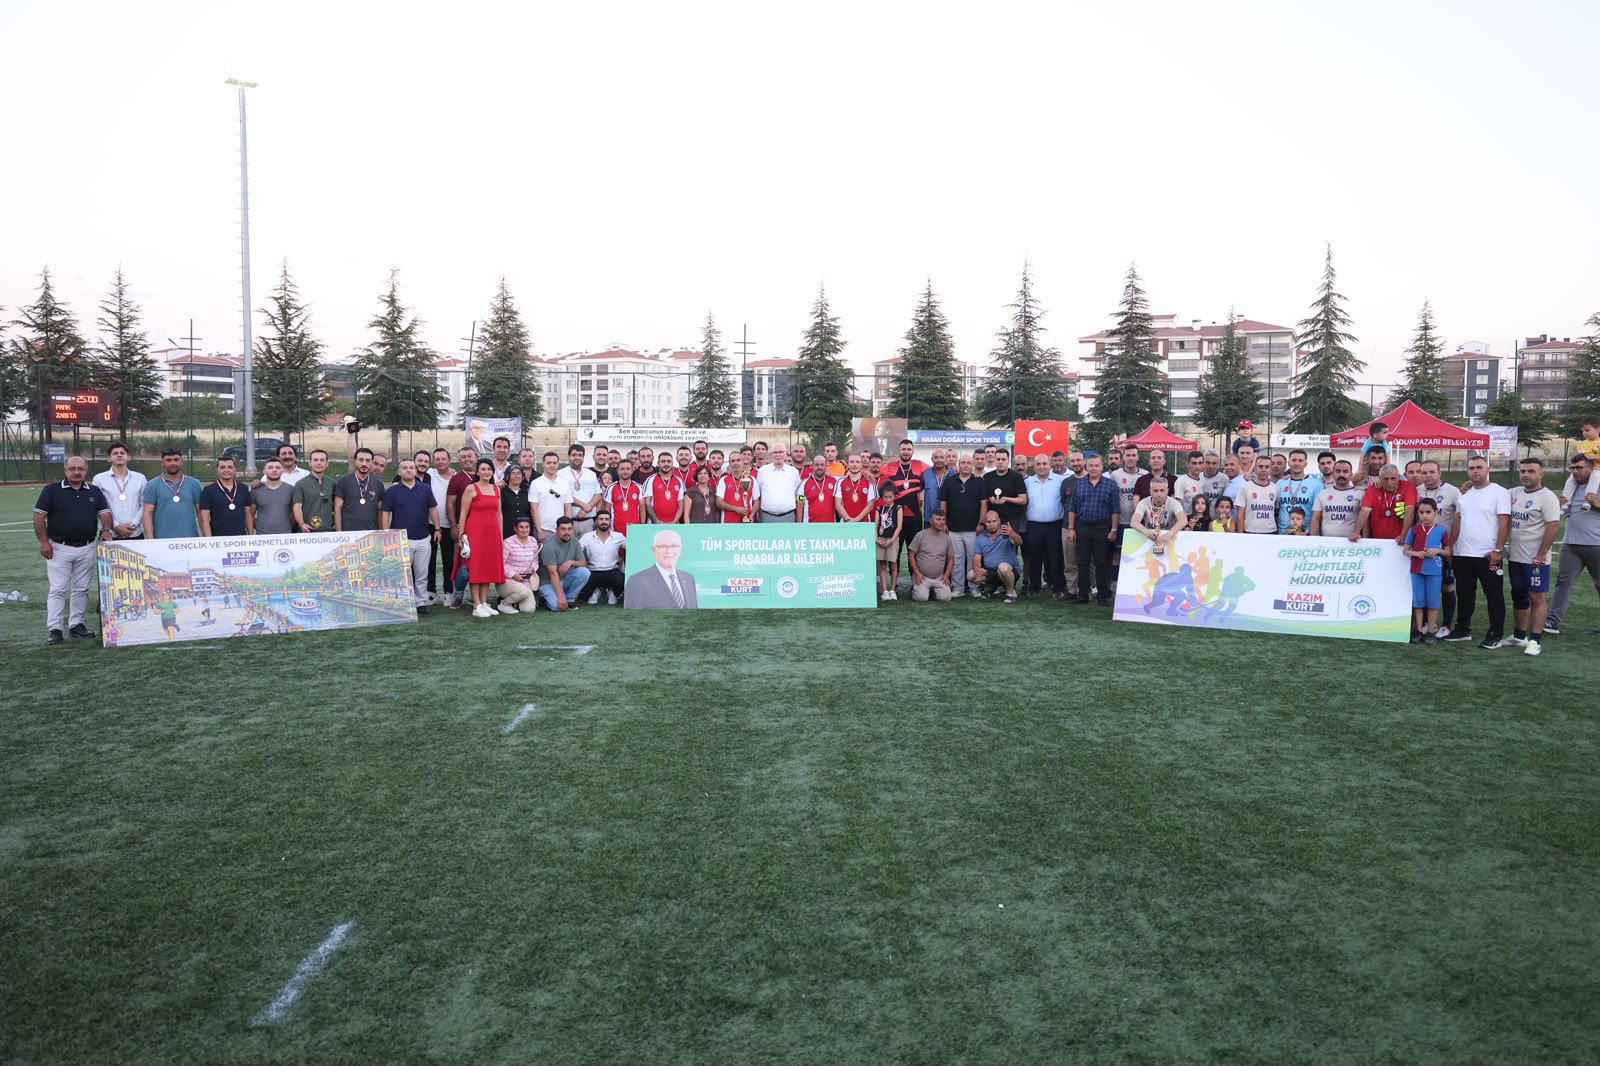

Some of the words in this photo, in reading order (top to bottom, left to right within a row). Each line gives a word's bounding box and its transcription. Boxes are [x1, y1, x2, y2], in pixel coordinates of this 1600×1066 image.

[104, 412, 110, 420] 0
[1393, 438, 1441, 446] ODUNPAZARI
[1442, 438, 1484, 447] BELEDİYESİ
[1325, 505, 1354, 513] BAMBAM
[1256, 512, 1270, 520] CAM
[1330, 513, 1347, 521] CAM
[168, 541, 207, 551] GENÇLİK
[223, 540, 247, 548] SPOR
[249, 537, 298, 547] HİZMETLERİ
[299, 535, 350, 544] MÜDÜRLÜĞÜ
[701, 537, 722, 551] TÜM
[725, 539, 792, 551] SPORCULARA
[794, 539, 807, 551] VE
[809, 538, 867, 551] TAKIMLARA
[230, 551, 256, 559] KAZIM
[1278, 545, 1330, 560] GENÇLİK
[1331, 548, 1346, 557] VE
[1347, 547, 1382, 557] SPOR
[733, 553, 791, 566] BAŞARILAR
[1293, 559, 1363, 571] HİZMETLERİ
[730, 578, 759, 586] KAZIM
[808, 575, 836, 584] GENÇLİK
[846, 573, 864, 581] SPOR
[1289, 573, 1365, 585] MÜDÜRLÜĞÜ
[1530, 576, 1541, 587] 15
[816, 580, 855, 590] HİZMETLERİ
[816, 589, 856, 599] MÜDÜRLÜĞÜ
[1286, 592, 1323, 603] KAZIM
[1285, 601, 1315, 612] KURT
